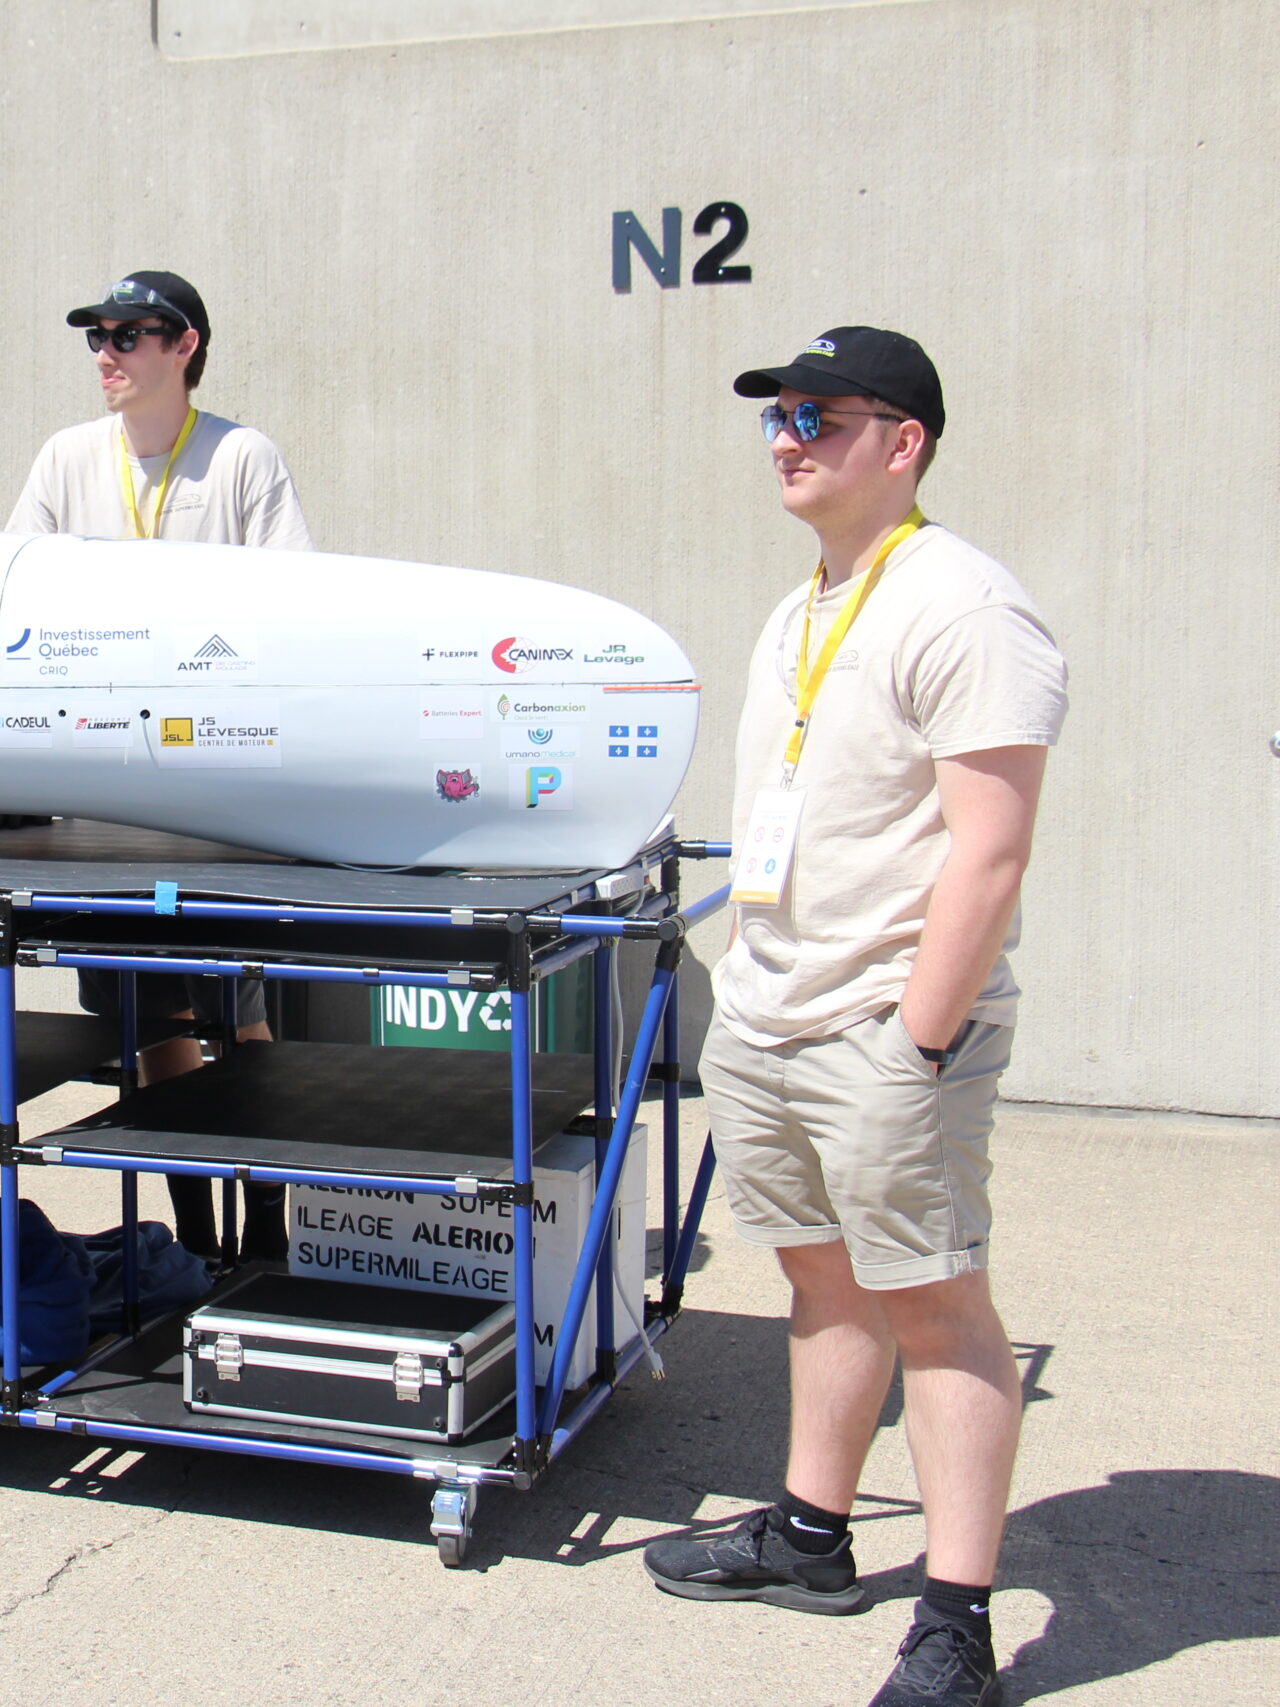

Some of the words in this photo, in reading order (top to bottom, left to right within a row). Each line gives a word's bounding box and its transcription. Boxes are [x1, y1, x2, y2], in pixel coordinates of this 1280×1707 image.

[612, 201, 752, 294] N2
[39, 627, 151, 641] Investissement
[39, 643, 99, 660] Québec
[439, 650, 479, 658] FLEXPIPE
[508, 648, 574, 662] CANIMEX
[601, 644, 626, 654] JR
[177, 661, 213, 671] AMT
[583, 654, 645, 666] Levage
[39, 665, 69, 676] CRIQ
[514, 702, 586, 713] Carbonaxion
[5, 716, 51, 728] CADEUL
[198, 717, 216, 726] JS
[198, 727, 279, 738] LEVESQUE
[198, 739, 225, 747] CENTRE
[227, 739, 236, 747] DE
[238, 739, 266, 747] MOTEUR
[385, 984, 479, 1033] INDY
[296, 1205, 395, 1241] ILEAGE
[297, 1241, 510, 1294] SUPERMILEAGE
